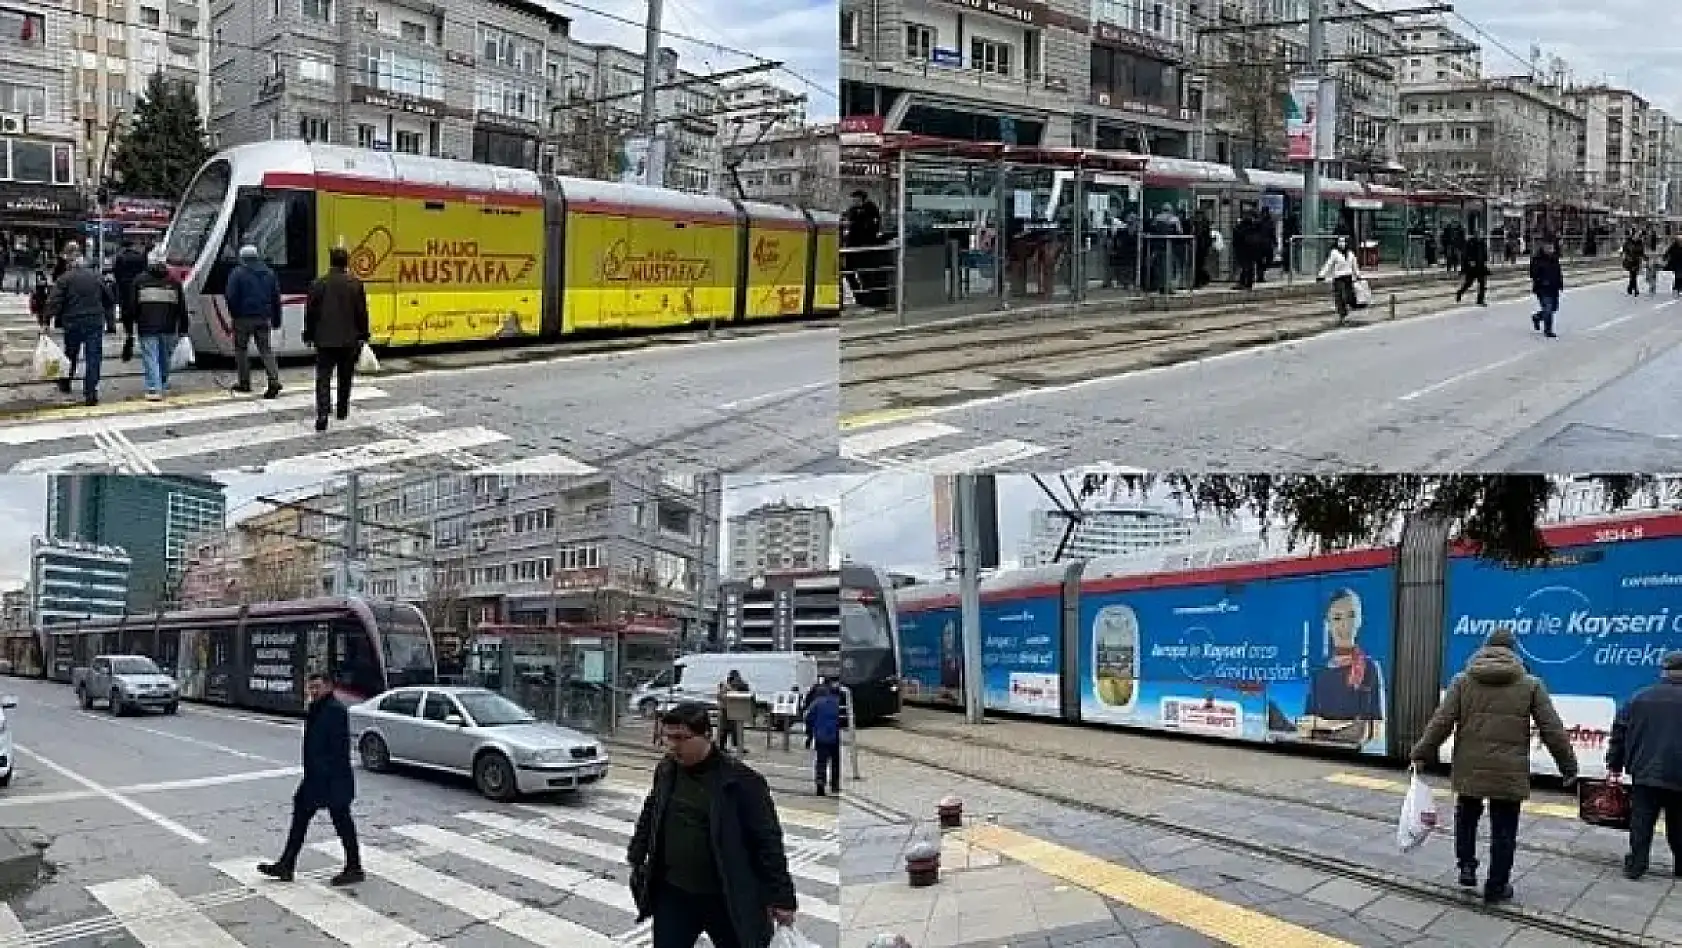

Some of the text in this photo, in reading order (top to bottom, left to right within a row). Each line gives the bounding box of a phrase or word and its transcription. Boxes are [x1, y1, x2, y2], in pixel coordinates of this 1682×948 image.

[398, 259, 510, 284] MUSTAFA
[1536, 611, 1562, 635] ile
[1565, 607, 1669, 638] Kayseri
